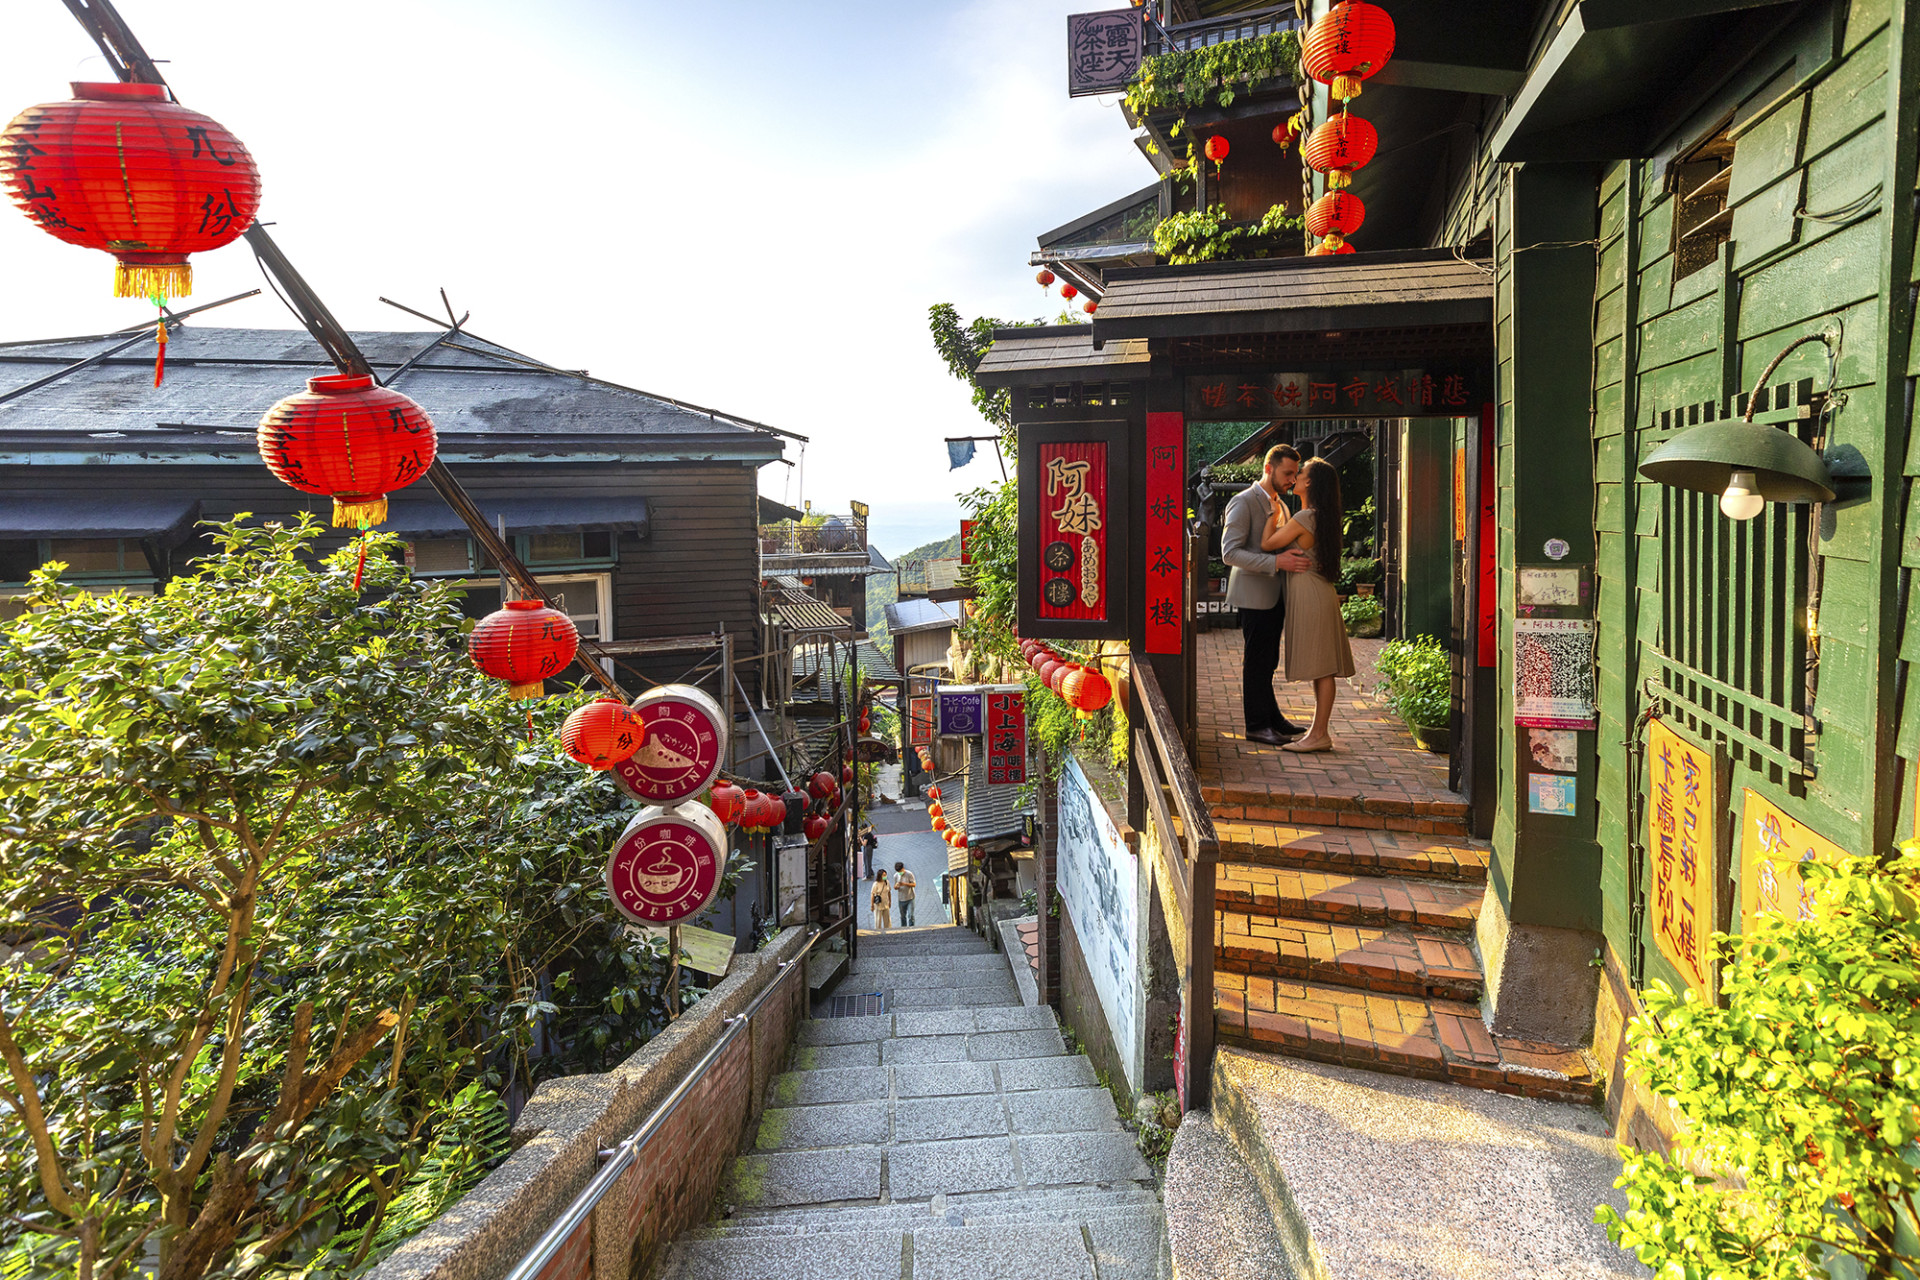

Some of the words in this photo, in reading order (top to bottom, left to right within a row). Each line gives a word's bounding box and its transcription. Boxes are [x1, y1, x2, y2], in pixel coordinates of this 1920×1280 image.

[185, 125, 242, 237] 九份
[387, 407, 424, 482] 九份
[1047, 457, 1101, 535] 阿妹
[1150, 445, 1180, 627] 阿妹茶樓
[1049, 547, 1070, 602] 茶樓
[539, 621, 563, 674] 九份
[616, 708, 636, 750] 九份
[994, 695, 1019, 753] 小上海
[624, 760, 709, 794] OCARINA
[991, 769, 1021, 781] 茶樓
[622, 889, 704, 917] COFFEE
